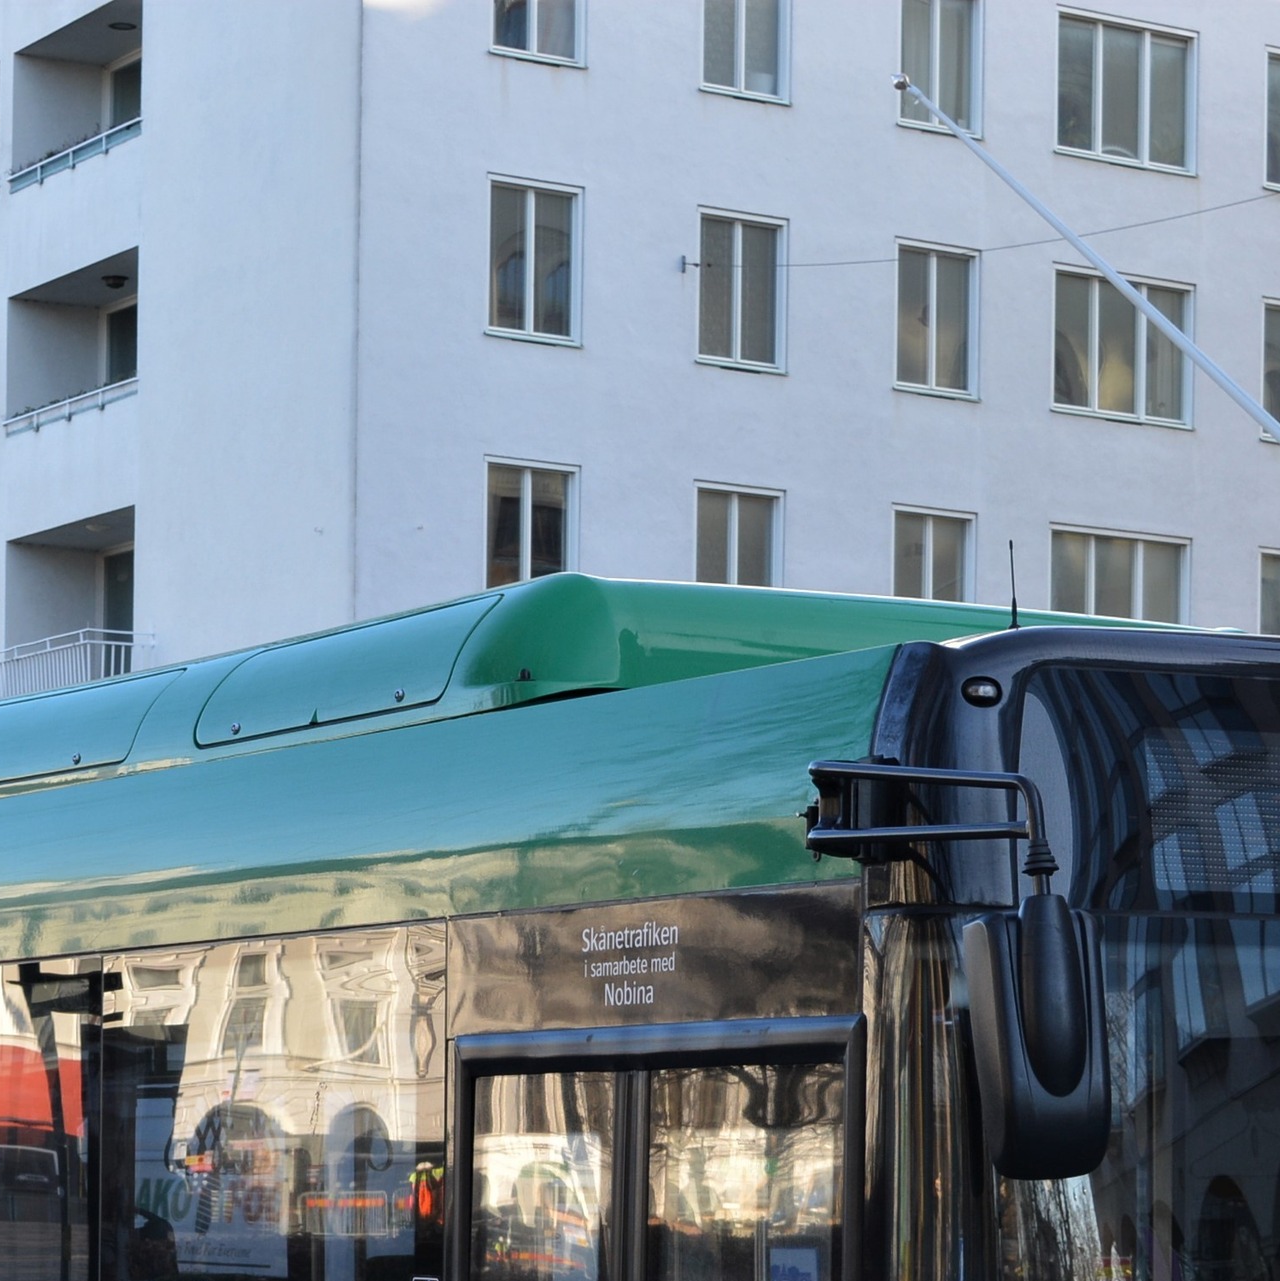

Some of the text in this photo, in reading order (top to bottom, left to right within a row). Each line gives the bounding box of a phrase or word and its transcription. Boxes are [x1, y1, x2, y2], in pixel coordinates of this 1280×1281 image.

[581, 921, 679, 952] Skånetrafiken
[590, 955, 648, 978] samarbete
[650, 951, 675, 972] med
[604, 980, 654, 1007] Nobina
